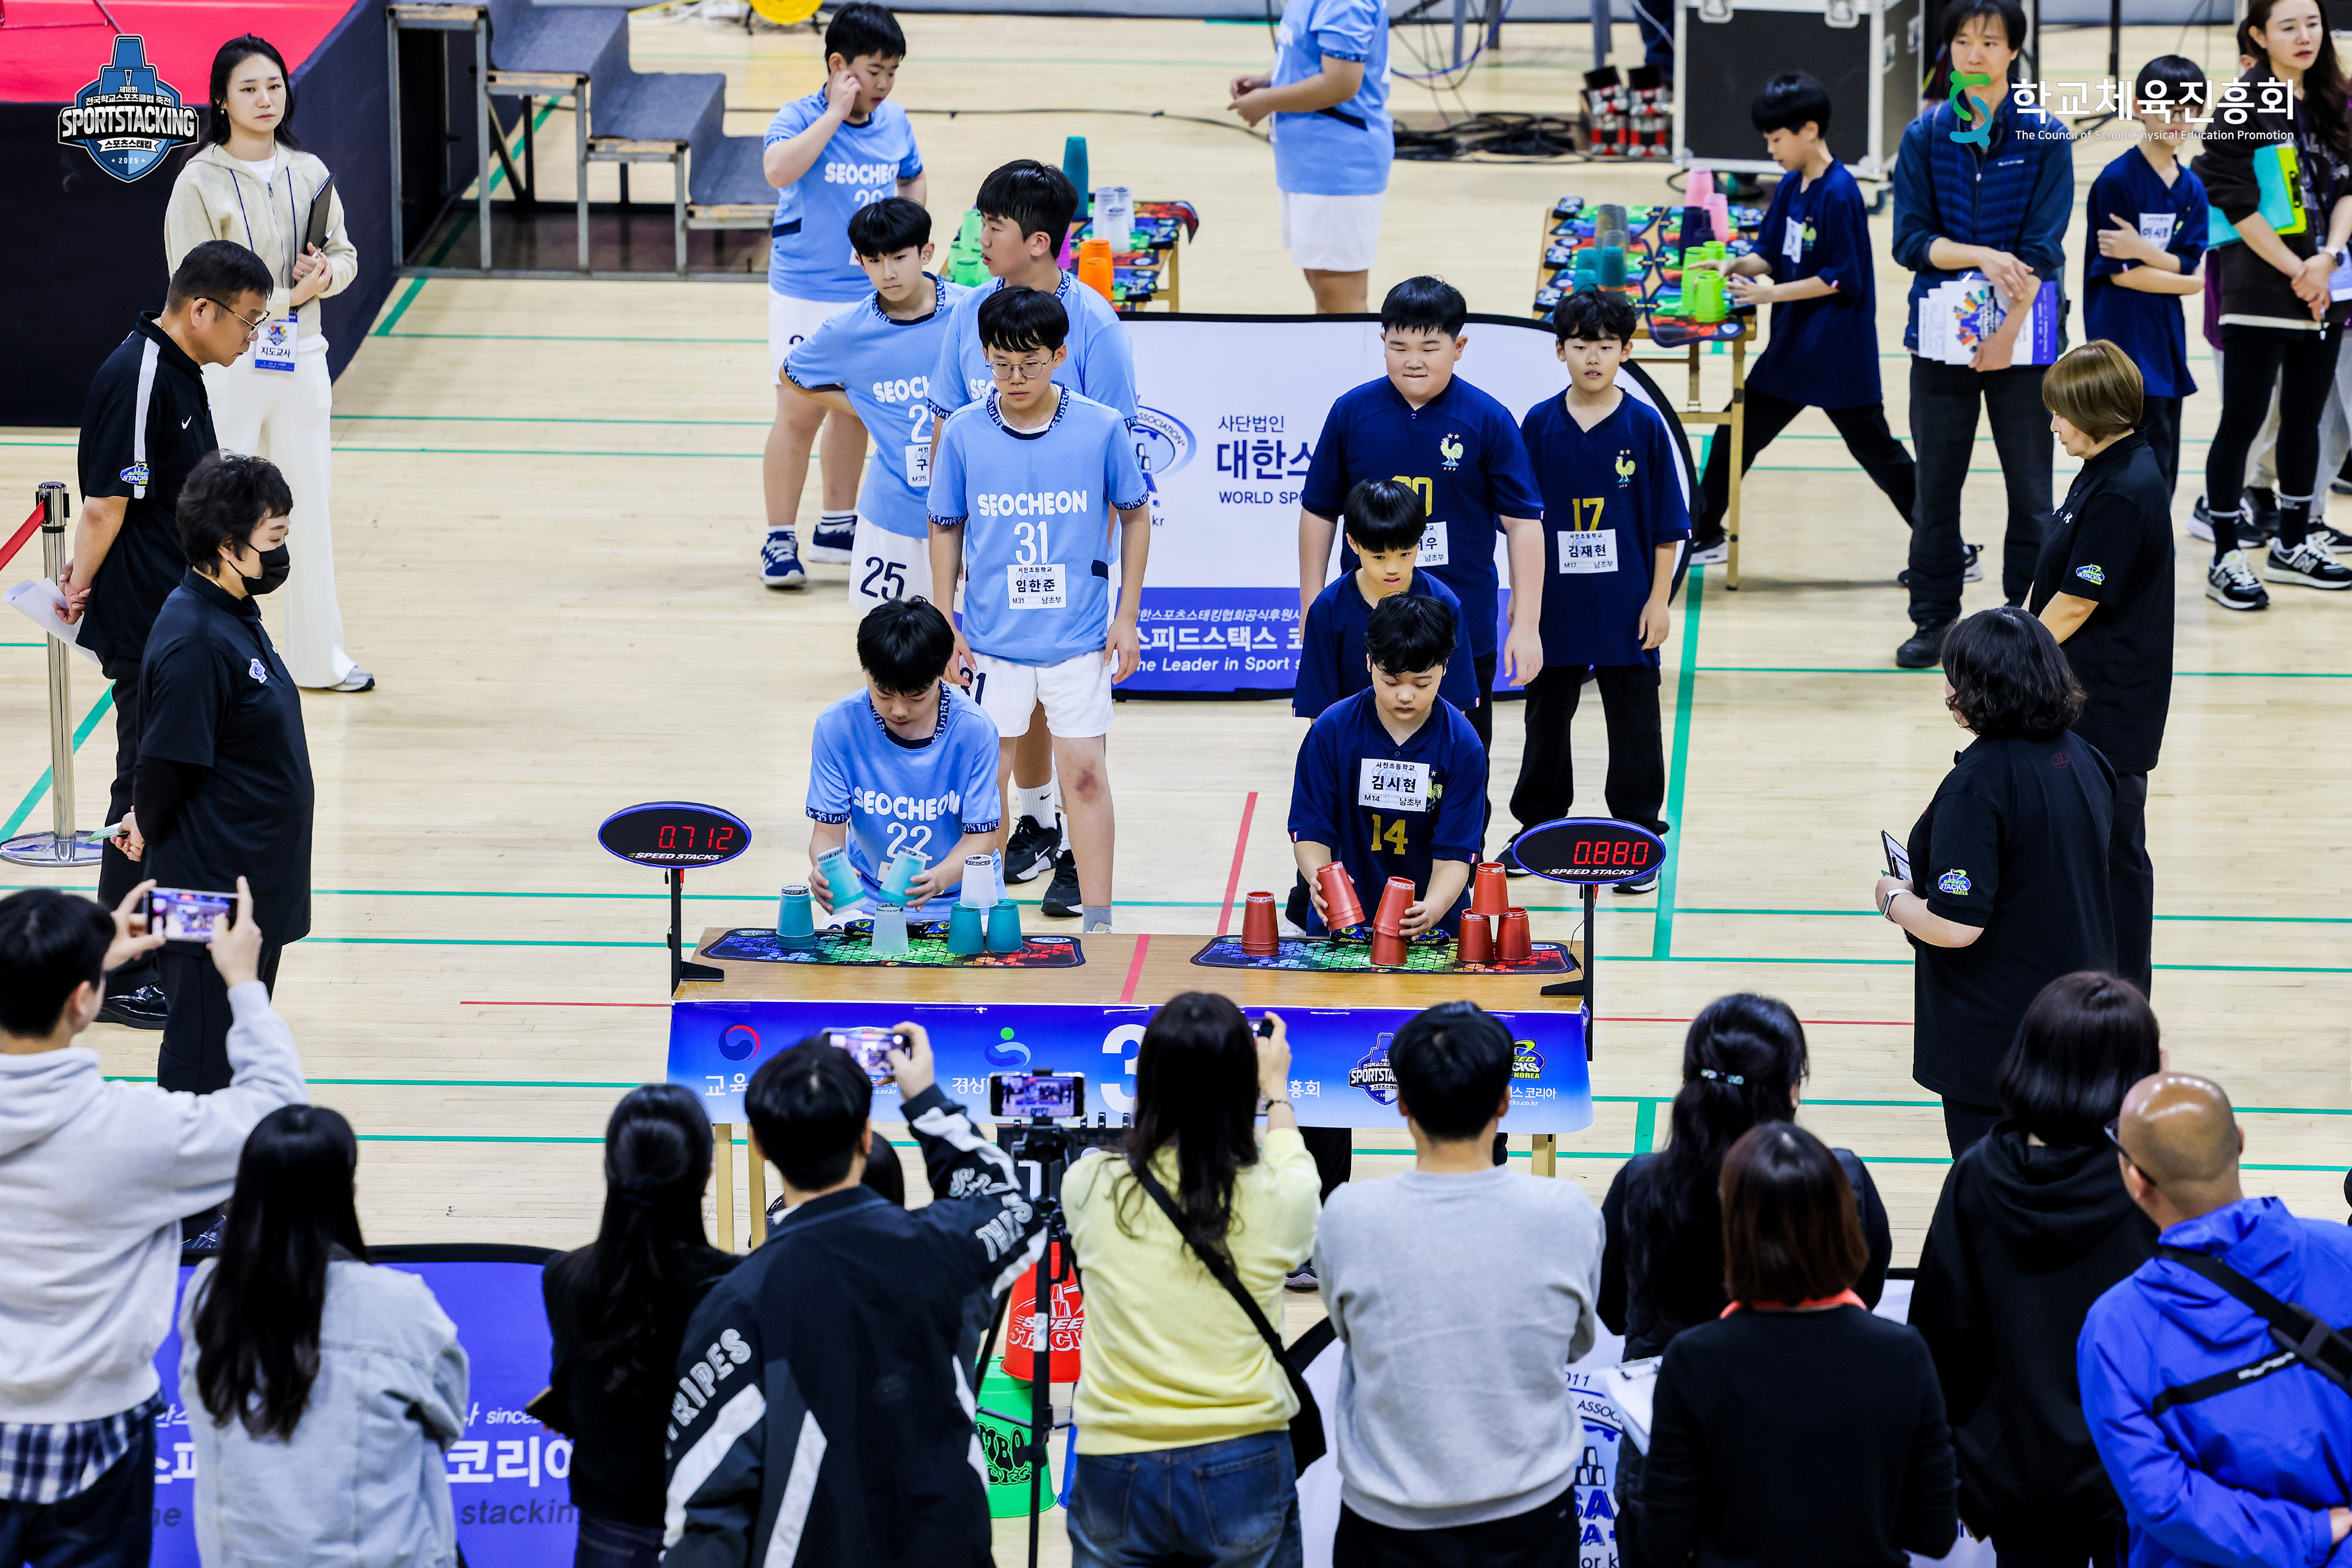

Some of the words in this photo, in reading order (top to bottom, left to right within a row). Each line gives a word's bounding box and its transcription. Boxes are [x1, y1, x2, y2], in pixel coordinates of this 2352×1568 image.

[824, 162, 900, 185] SEOCHEO
[261, 346, 290, 358] 지도교사
[908, 404, 934, 443] 2
[1218, 415, 1284, 432] 사단법인
[977, 490, 1087, 517] SEOCHEON
[1220, 491, 1273, 504] WORLD
[1279, 492, 1302, 504] SP
[1572, 497, 1605, 531] 17
[1013, 521, 1048, 565] 31
[1569, 544, 1606, 557] 김재현
[1425, 554, 1444, 562] 남초부
[860, 556, 907, 601] 25
[1016, 579, 1055, 593] 임한준
[1137, 658, 1156, 671] he
[1162, 657, 1219, 672] Leader
[1224, 657, 1238, 671] in
[1245, 656, 1289, 672] Sport
[1372, 775, 1416, 793] 김시현
[853, 786, 960, 821] SEOCHEON
[1399, 797, 1422, 807] 남초부
[659, 825, 734, 850] 0.712
[886, 822, 933, 861] 22
[1371, 814, 1408, 855] 14
[1573, 841, 1649, 865] 0.880
[1940, 883, 1968, 891] STACKS
[1101, 1024, 1147, 1114] 3
[1525, 1088, 1557, 1099] 코리아
